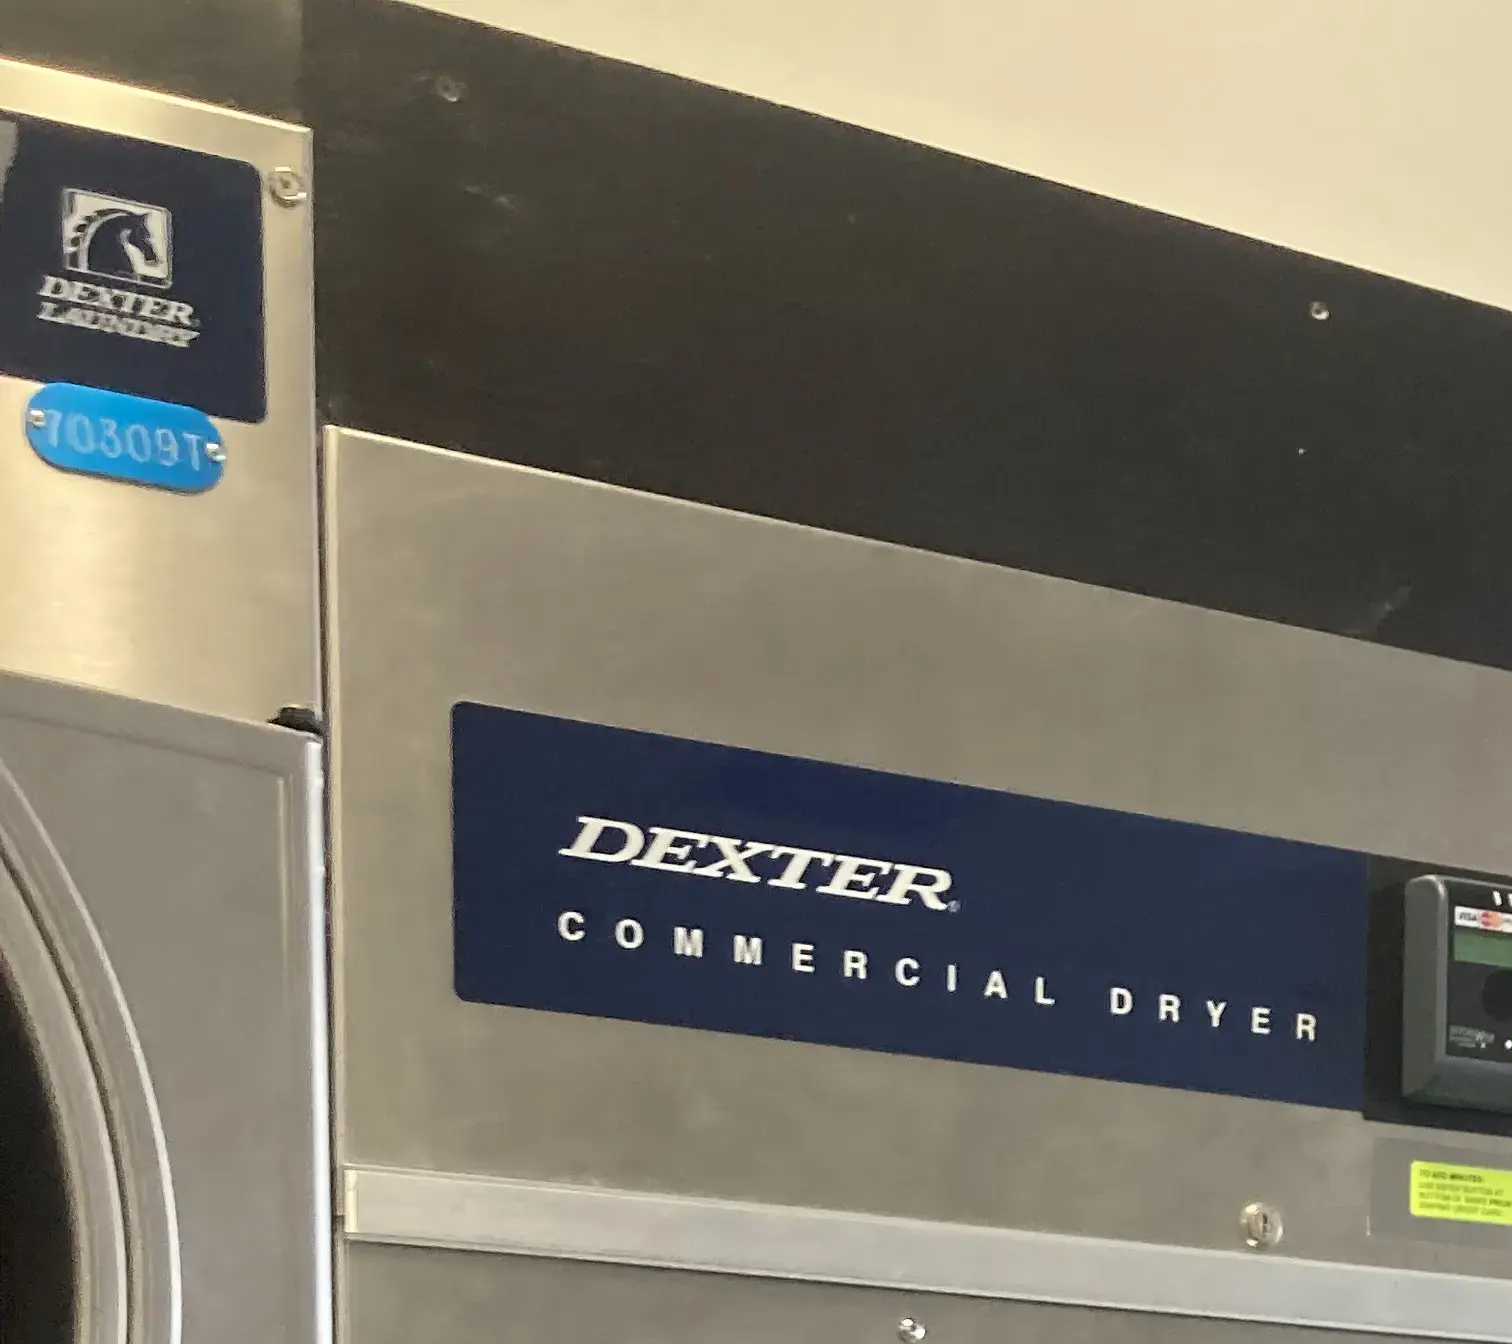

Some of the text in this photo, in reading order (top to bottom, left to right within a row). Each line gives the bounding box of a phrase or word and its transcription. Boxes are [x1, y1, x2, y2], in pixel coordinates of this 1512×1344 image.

[37, 275, 195, 327] DEXTER
[37, 301, 200, 348] LAUNDRY
[43, 409, 205, 472] 70309T
[558, 815, 953, 912] DEXTER
[557, 910, 1318, 1043] COMMERCIAL DRYER
